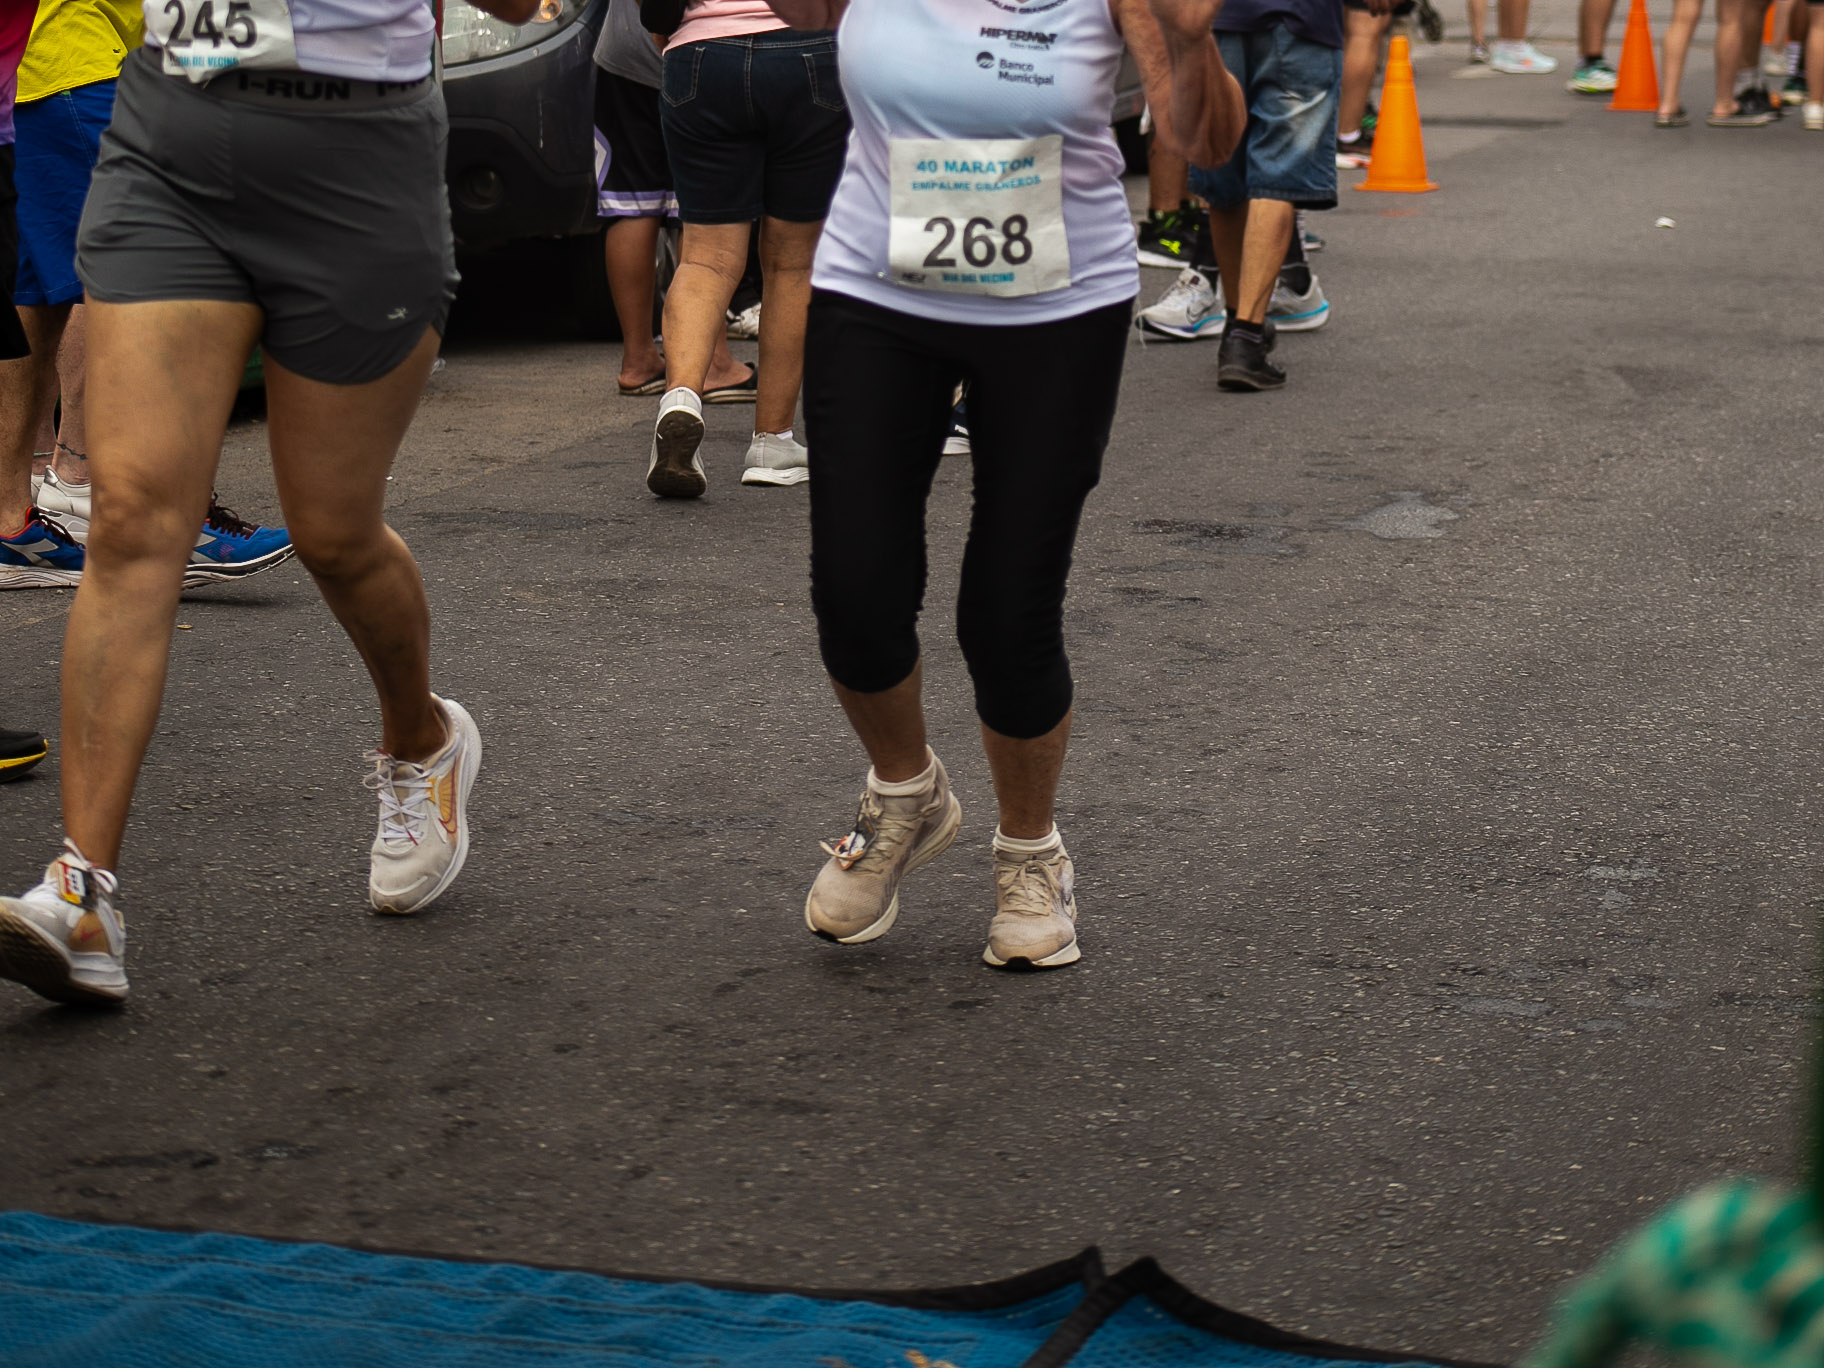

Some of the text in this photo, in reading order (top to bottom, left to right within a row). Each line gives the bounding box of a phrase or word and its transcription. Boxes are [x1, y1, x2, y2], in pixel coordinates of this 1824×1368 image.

[163, 0, 258, 48] 245
[1000, 59, 1034, 72] Banco
[237, 74, 350, 100] I-RUN
[998, 70, 1054, 86] Municipal
[916, 156, 1035, 174] 40 MARATON
[912, 181, 971, 191] EMPALME
[923, 214, 1032, 267] 268
